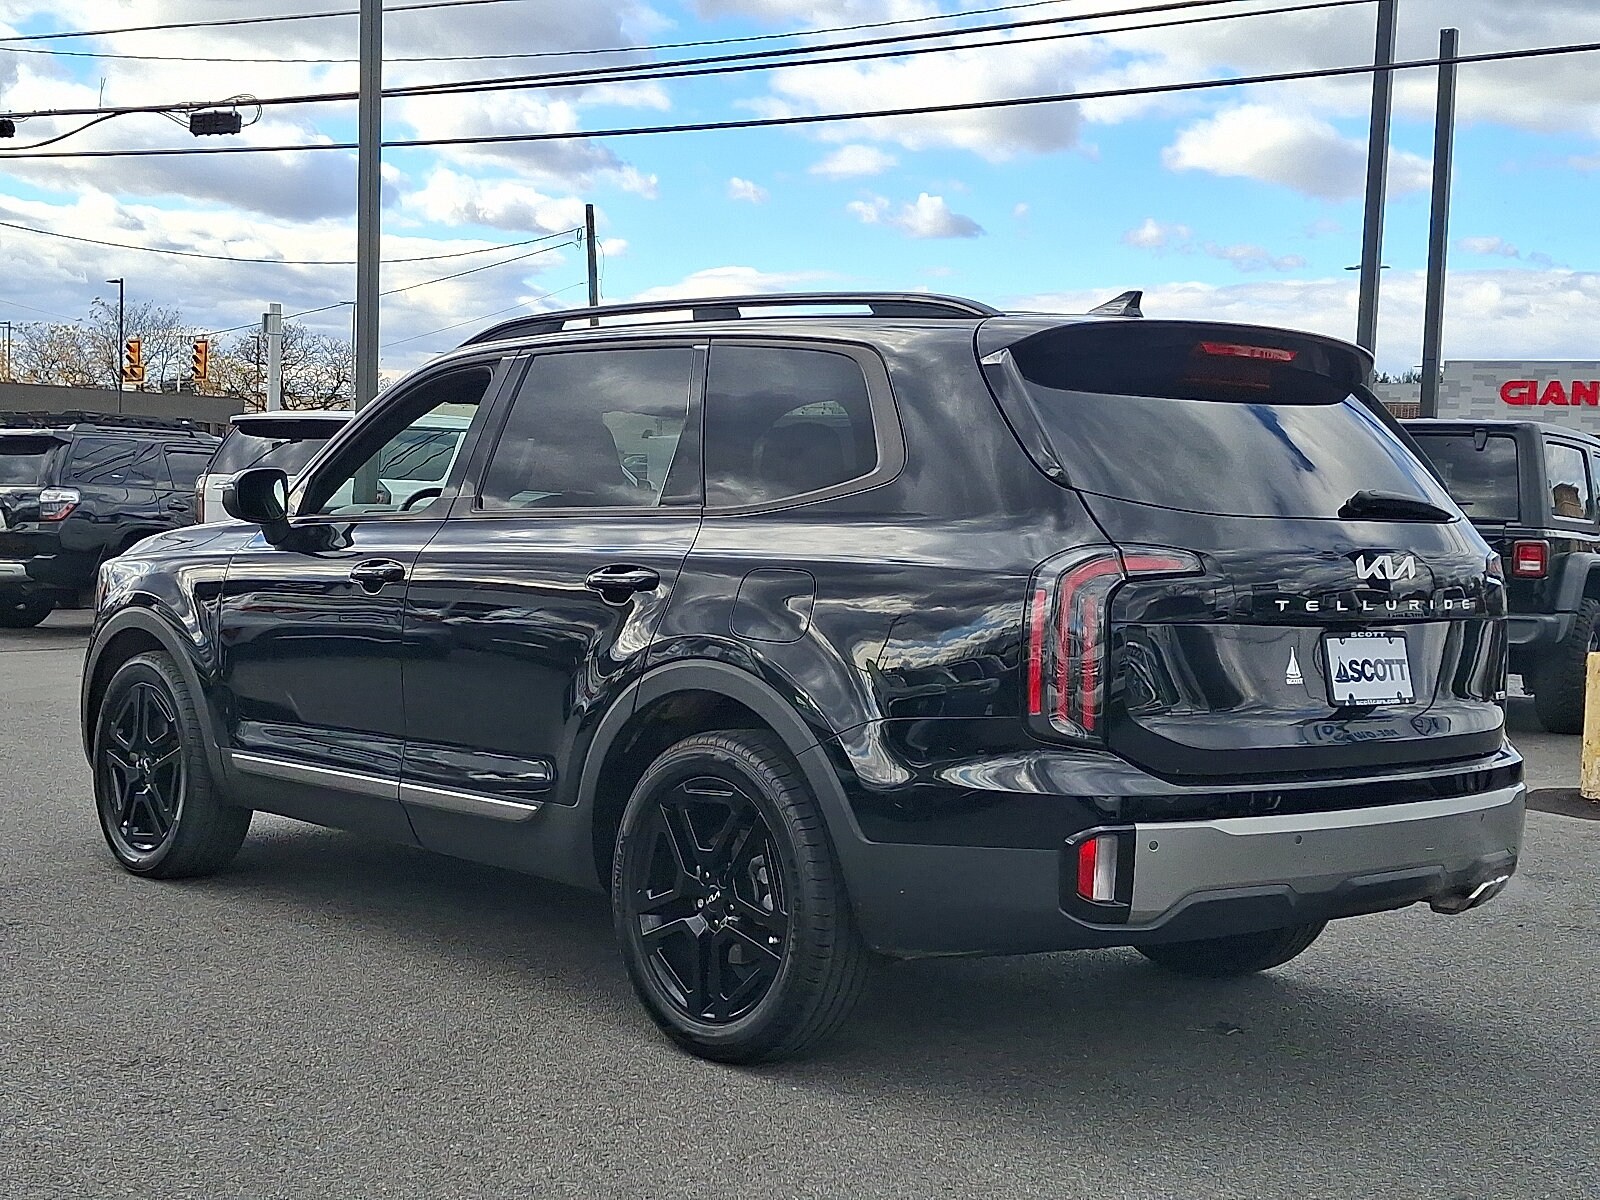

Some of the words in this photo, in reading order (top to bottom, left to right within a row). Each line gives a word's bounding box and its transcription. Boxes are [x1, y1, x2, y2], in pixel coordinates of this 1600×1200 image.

[1356, 554, 1416, 580] KIA
[1274, 599, 1472, 612] TELLURIDE
[1349, 658, 1406, 683] SCOTT
